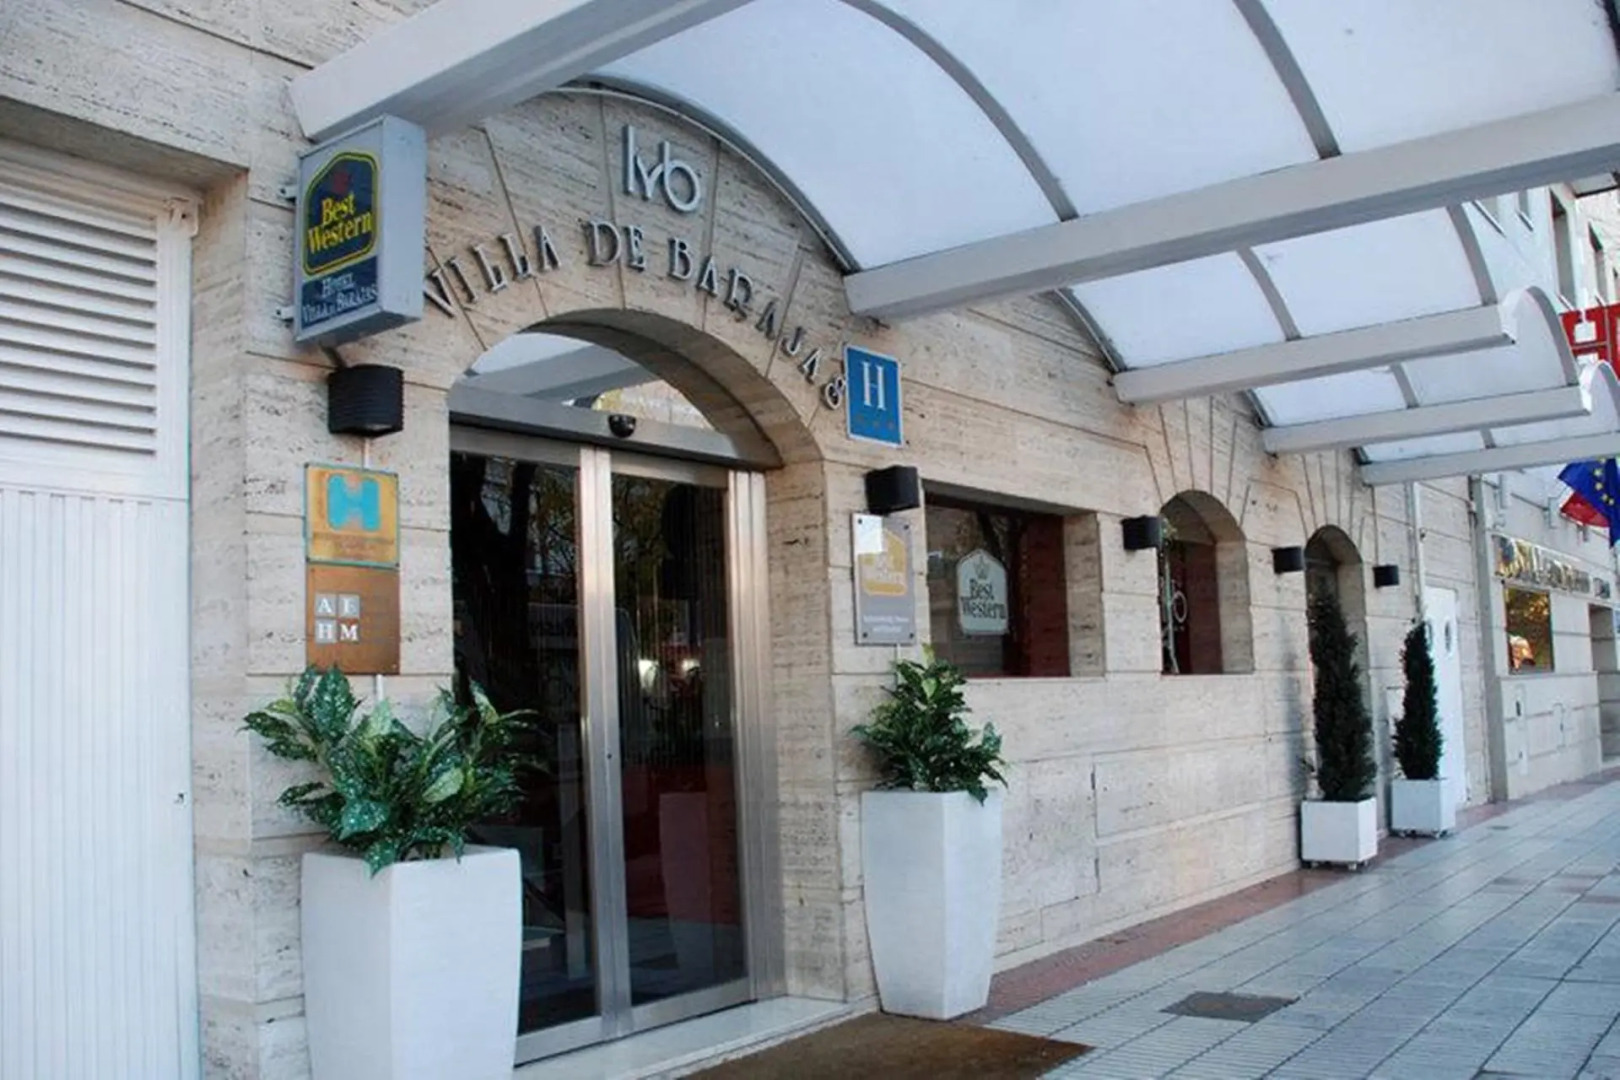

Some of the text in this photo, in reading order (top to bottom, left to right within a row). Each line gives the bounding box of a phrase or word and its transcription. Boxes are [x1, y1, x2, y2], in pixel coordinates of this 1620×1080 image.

[321, 192, 356, 226] Best
[307, 211, 374, 254] Western
[423, 220, 847, 411] VILLA DE BARAJAS
[861, 361, 886, 411] H
[969, 578, 995, 601] Best
